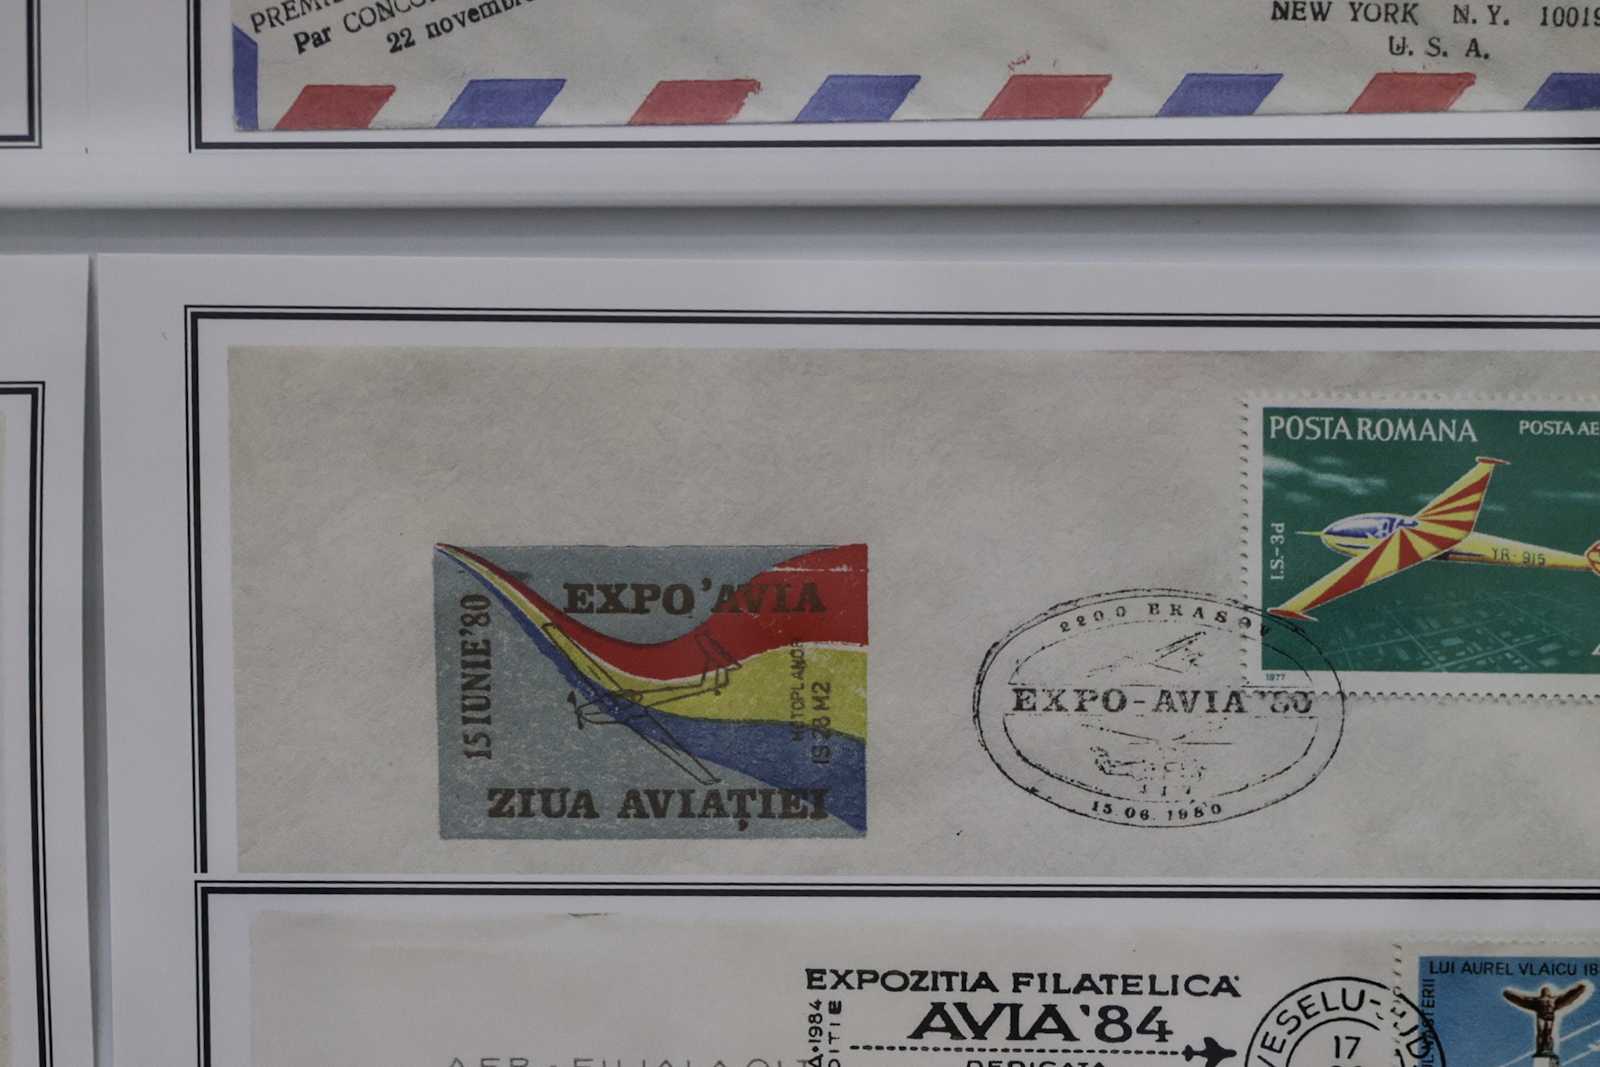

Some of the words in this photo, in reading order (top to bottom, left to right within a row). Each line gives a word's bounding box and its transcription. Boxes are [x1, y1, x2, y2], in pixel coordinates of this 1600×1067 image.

[250, 0, 342, 33] PREM
[293, 26, 332, 54] Par
[343, 0, 437, 33] CONC
[387, 27, 417, 53] 22
[425, 0, 534, 39] novemb
[1271, 1, 1333, 22] NEW
[1350, 2, 1420, 26] YORK
[1269, 415, 1353, 441] POSTA
[1356, 417, 1478, 443] ROMANA
[1518, 420, 1576, 437] POSTA
[1060, 605, 1126, 633] 2200
[460, 593, 492, 731] IUNIE'80
[461, 732, 492, 761] 15
[487, 787, 600, 819] ZIUA
[805, 968, 999, 993] EXPOZITIA
[1011, 972, 1242, 998] FILATELICA
[1429, 961, 1456, 975] LUI
[1460, 961, 1514, 976] AUREL
[1518, 962, 1577, 977] VLAICU
[906, 1002, 1174, 1044] AVIA'84
[1334, 1035, 1361, 1059] 17
